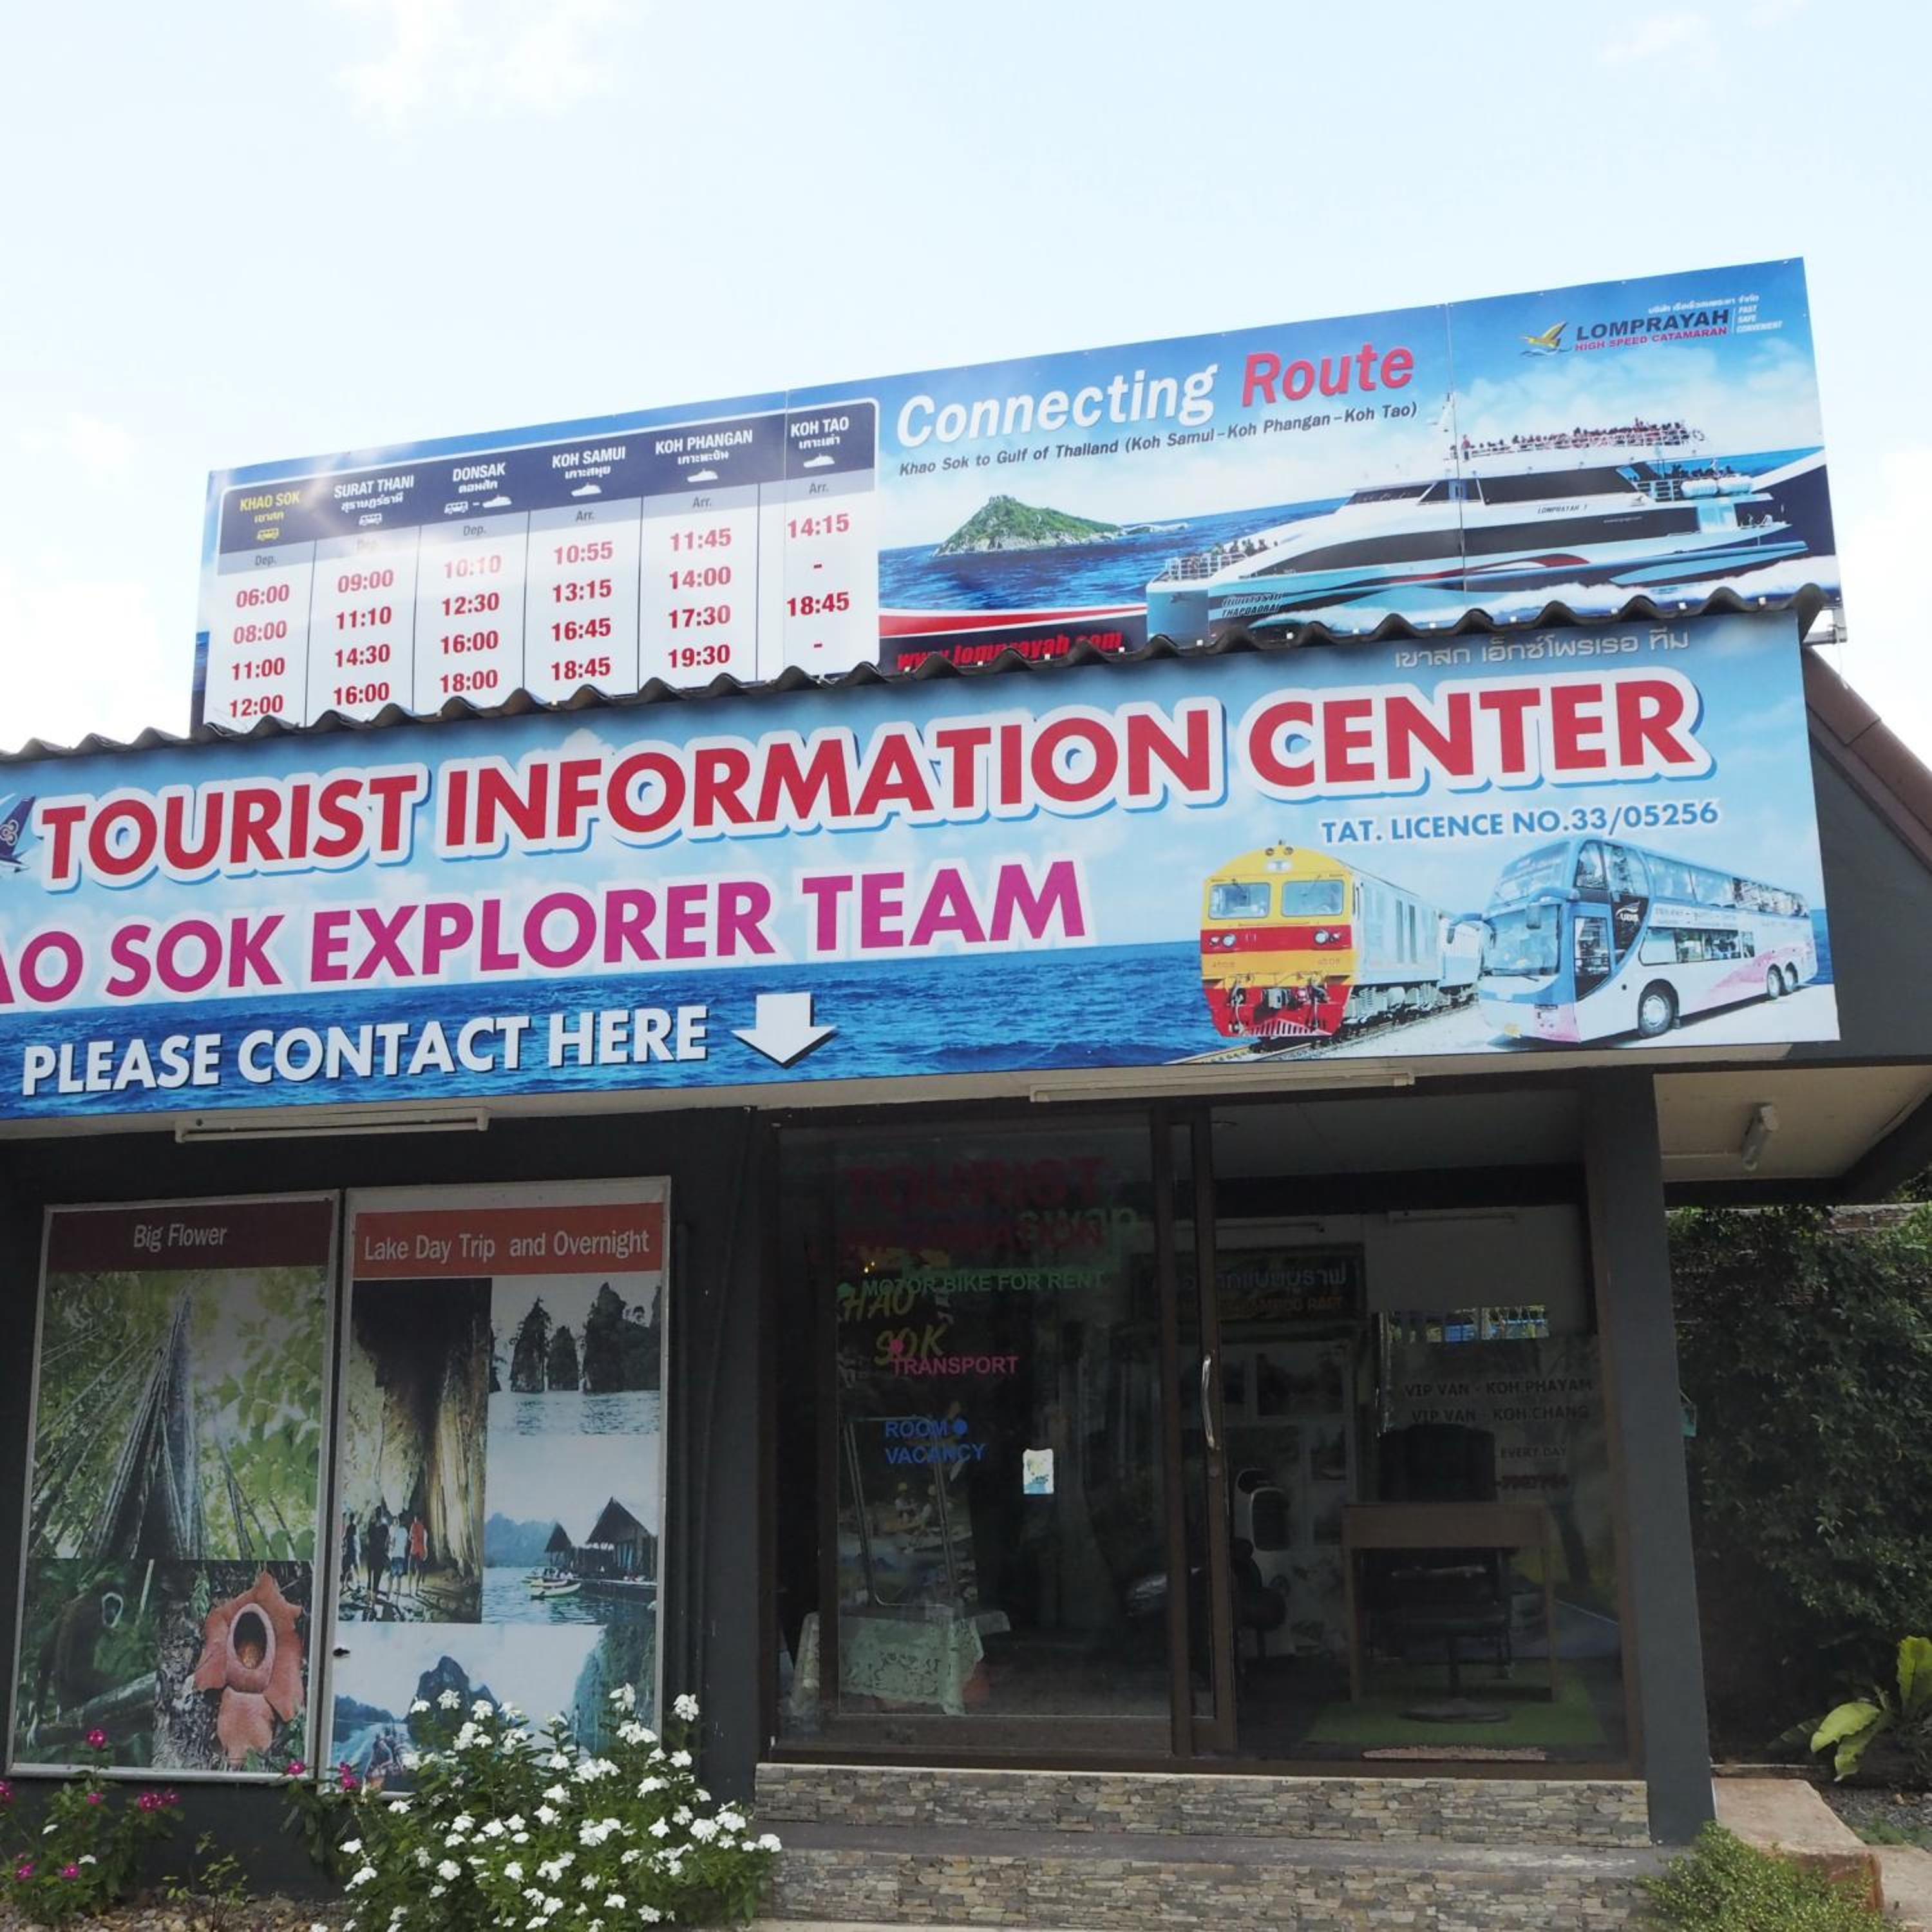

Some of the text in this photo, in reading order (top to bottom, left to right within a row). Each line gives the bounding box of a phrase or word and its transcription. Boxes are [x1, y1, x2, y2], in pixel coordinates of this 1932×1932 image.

[1577, 308, 1729, 341] LOMPRAYAH
[1575, 327, 1727, 352] HIGH SPEED CATAMARAN
[897, 343, 1415, 448] Connecting Route
[791, 416, 850, 439] KOH TAO
[899, 461, 936, 477] Khao
[942, 457, 969, 471] Sok
[976, 453, 990, 467] to
[996, 448, 1029, 465] Gulf
[1033, 444, 1050, 461] of
[1056, 439, 1119, 459] Thailand
[1124, 434, 1160, 453] (Koh
[1382, 401, 1417, 419] Tao)
[655, 430, 753, 455] KOH PHANGAN
[552, 446, 626, 468] KOH SAMUI
[453, 462, 506, 482] DONSAK
[334, 474, 415, 499] SURAT THANI
[809, 483, 829, 495] Arr.
[240, 491, 300, 512] KHAO SOK
[692, 497, 712, 508] Arr.
[575, 511, 594, 522] Arr.
[788, 513, 850, 538] 14:15
[463, 524, 487, 536] Dep.
[670, 528, 732, 551] 11:45
[255, 554, 277, 567] Dep.
[554, 541, 613, 565] 10:55
[444, 554, 502, 579] 10:10
[669, 566, 732, 590] 14:00
[337, 569, 394, 594] 09:00
[553, 579, 612, 603] 13:15
[236, 584, 290, 608] 06:00
[442, 592, 500, 616] 12:30
[787, 591, 850, 616] 18:45
[336, 606, 392, 630] 11:10
[668, 605, 732, 629] 17:30
[233, 620, 287, 645] 08:00
[551, 618, 612, 642] 16:45
[440, 630, 499, 656] 16:00
[1395, 647, 1470, 668] เขาสก
[1649, 627, 1690, 650] ทีม
[335, 644, 390, 668] 14:30
[668, 644, 732, 668] 19:30
[231, 657, 285, 681] 11:00
[440, 669, 498, 693] 18:00
[551, 657, 611, 681] 18:45
[333, 682, 390, 706] 16:00
[229, 694, 283, 719] 12:00
[41, 679, 1697, 880] TOURIST INFORMATION CENTER
[1321, 820, 1381, 844] TAT.
[1390, 813, 1504, 841] LICENCE
[105, 914, 285, 998] SOK
[310, 880, 775, 982] EXPLORER
[801, 860, 1085, 951] TEAM
[23, 1005, 708, 1096] PLEASE CONTACT HERE
[134, 1222, 227, 1253] Big Flower
[364, 1229, 650, 1264] Lake Day Trip and Overnight
[862, 1269, 1105, 1296] MOTOR BIKE FOR RENT
[873, 1323, 949, 1366] SOK
[893, 1355, 1019, 1377] TRANSPORT
[1403, 1383, 1433, 1397] VIP
[1438, 1381, 1470, 1396] VAN
[1412, 1409, 1439, 1423] VIP
[1443, 1408, 1476, 1423] VAN
[886, 1420, 948, 1438] ROOM
[886, 1443, 987, 1464] VACANCY
